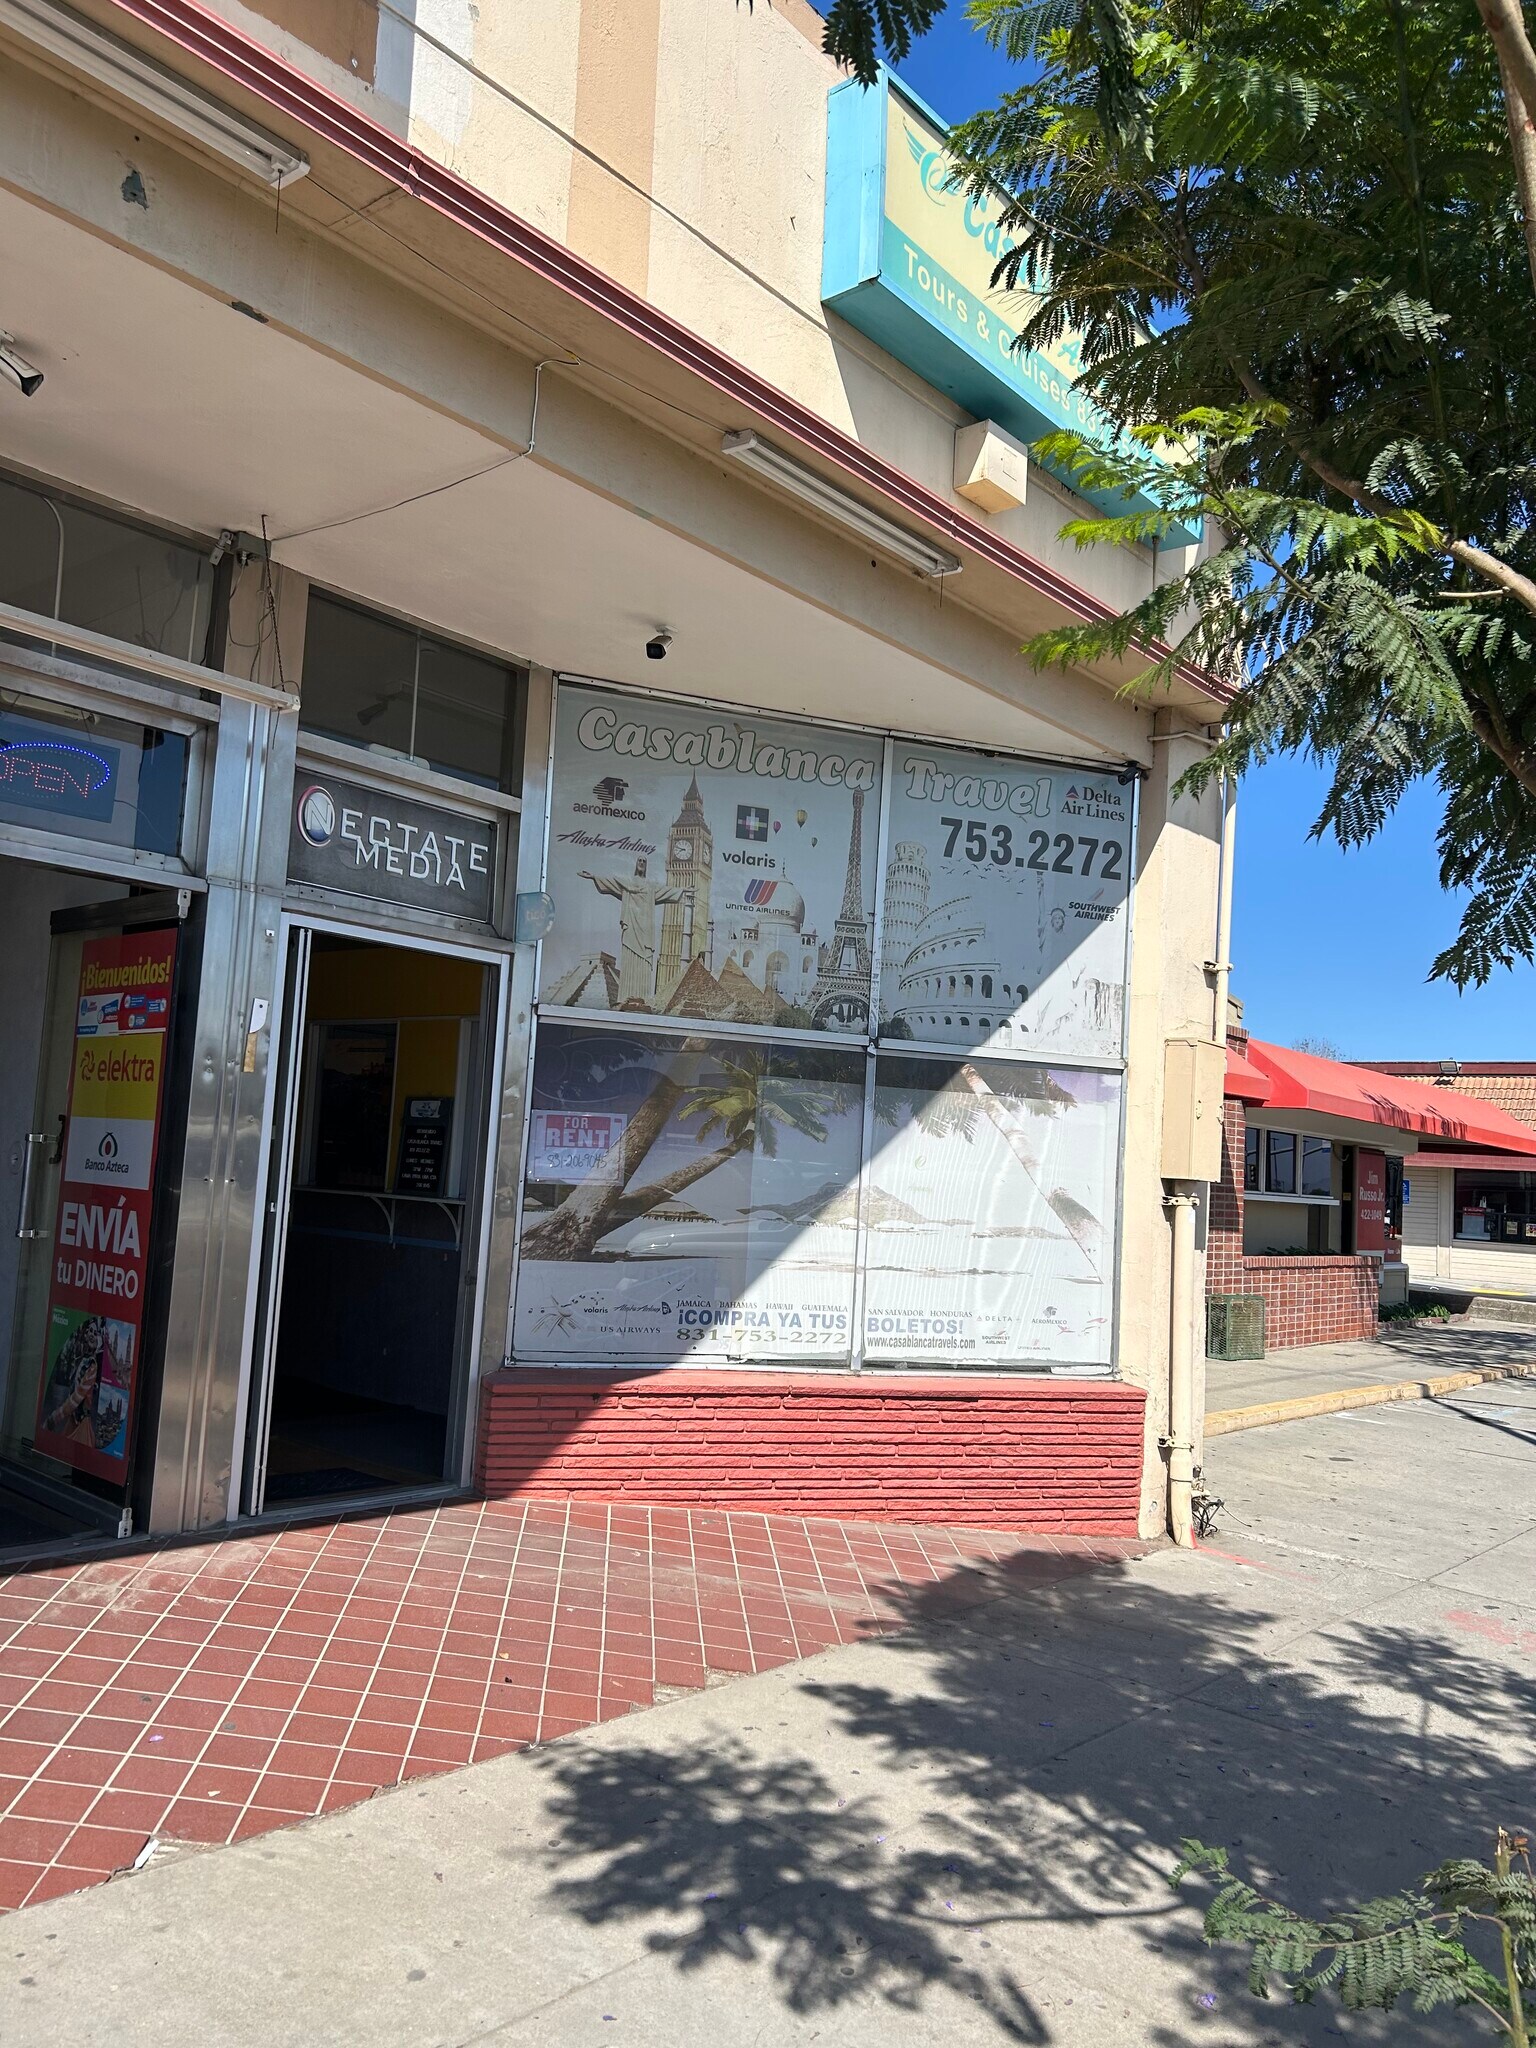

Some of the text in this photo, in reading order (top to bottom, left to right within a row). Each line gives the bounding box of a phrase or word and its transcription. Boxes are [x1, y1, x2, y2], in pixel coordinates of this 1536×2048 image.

[904, 243, 968, 323] Tours
[976, 310, 990, 343] &
[577, 706, 875, 791] Casablanca
[903, 757, 1052, 818] Travel
[1082, 786, 1122, 806] Delta
[573, 802, 646, 822] aeromexico
[1061, 801, 1125, 822] Air Lines
[557, 829, 657, 855] Alaska Airlines
[940, 816, 1123, 881] 753.2272
[355, 836, 466, 891] MEDIA
[722, 850, 776, 869] volaris
[725, 903, 791, 917] UNITED AIRLINES
[1068, 901, 1121, 914] SOUTHWEST
[1074, 910, 1115, 922] AIRLINES
[97, 1049, 155, 1082] elektra
[564, 1117, 588, 1129] FOR
[546, 1127, 609, 1148] RENT
[84, 1158, 129, 1174] Banco Azteca
[1367, 1170, 1379, 1185] Jim
[1359, 1186, 1377, 1202] Russo
[60, 1194, 141, 1258] ENVÍA
[57, 1257, 139, 1300] tu DINERO
[676, 1300, 711, 1308] JAMAICA
[719, 1301, 757, 1309] BAHAMAS
[765, 1302, 794, 1311] HAWAII
[801, 1304, 848, 1312] GUATEMALA
[868, 1308, 883, 1316] SAN
[885, 1309, 924, 1317] SALVADOR
[930, 1310, 973, 1318] HONDURAS
[616, 1326, 661, 1334] AIRWAYS
[778, 1312, 802, 1328] YA
[809, 1313, 847, 1330] TUS
[867, 1317, 964, 1334] BOLETOS!
[676, 1328, 847, 1344] 831-753-2272
[867, 1334, 976, 1350] www.casablancatravels.com
